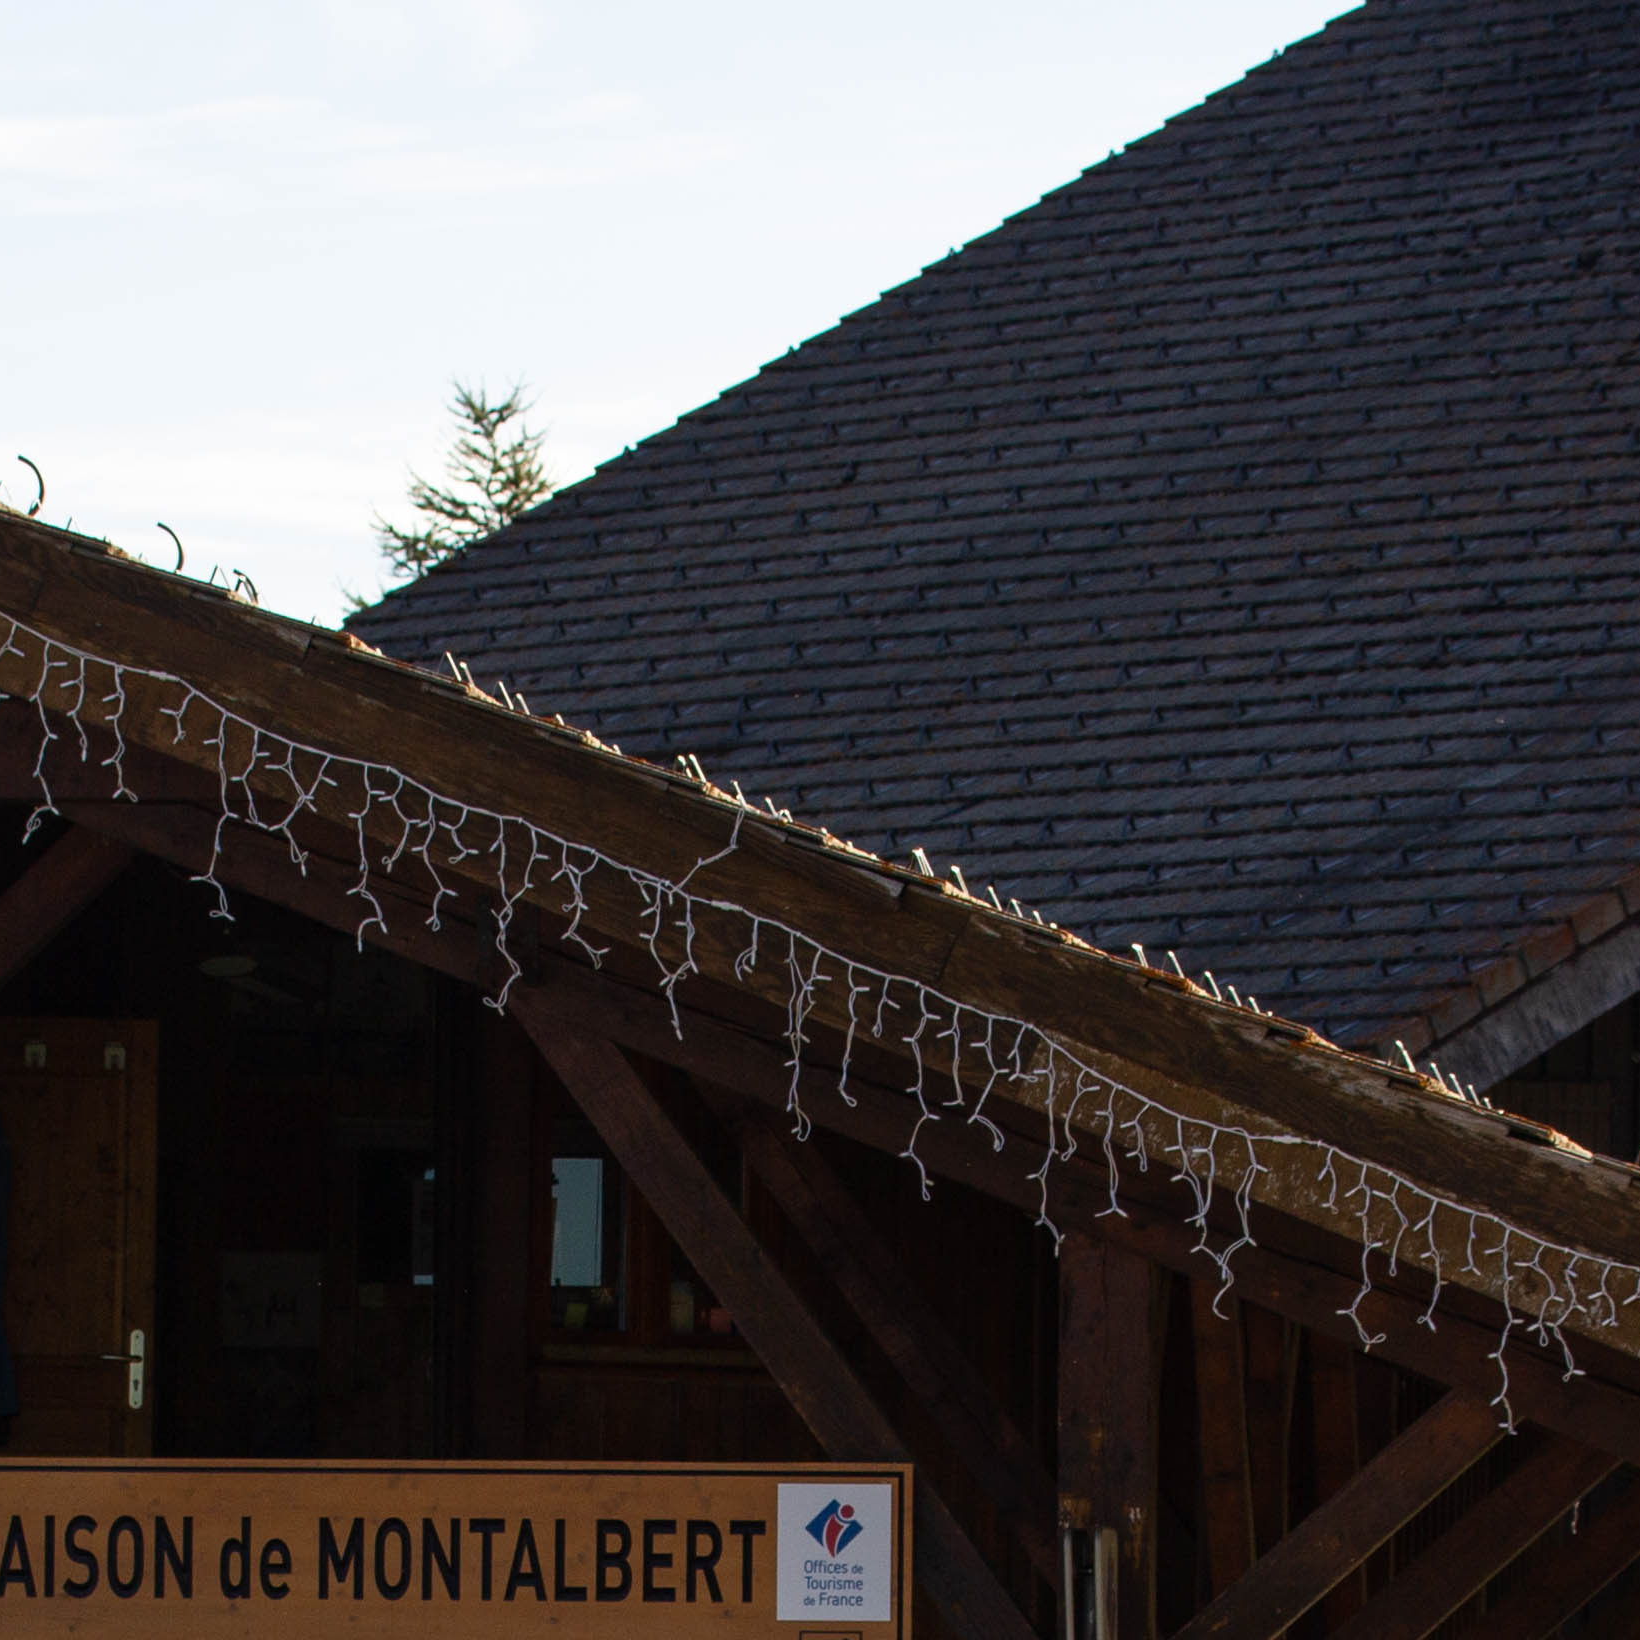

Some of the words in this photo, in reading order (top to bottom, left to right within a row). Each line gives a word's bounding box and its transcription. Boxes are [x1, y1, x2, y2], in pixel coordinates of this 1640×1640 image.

[220, 1516, 293, 1601] de
[318, 1517, 767, 1603] MONTALBERT
[804, 1560, 848, 1574] Offices
[851, 1564, 863, 1574] de
[804, 1576, 863, 1590] Tourisme
[803, 1596, 815, 1606] de
[818, 1592, 863, 1606] France
